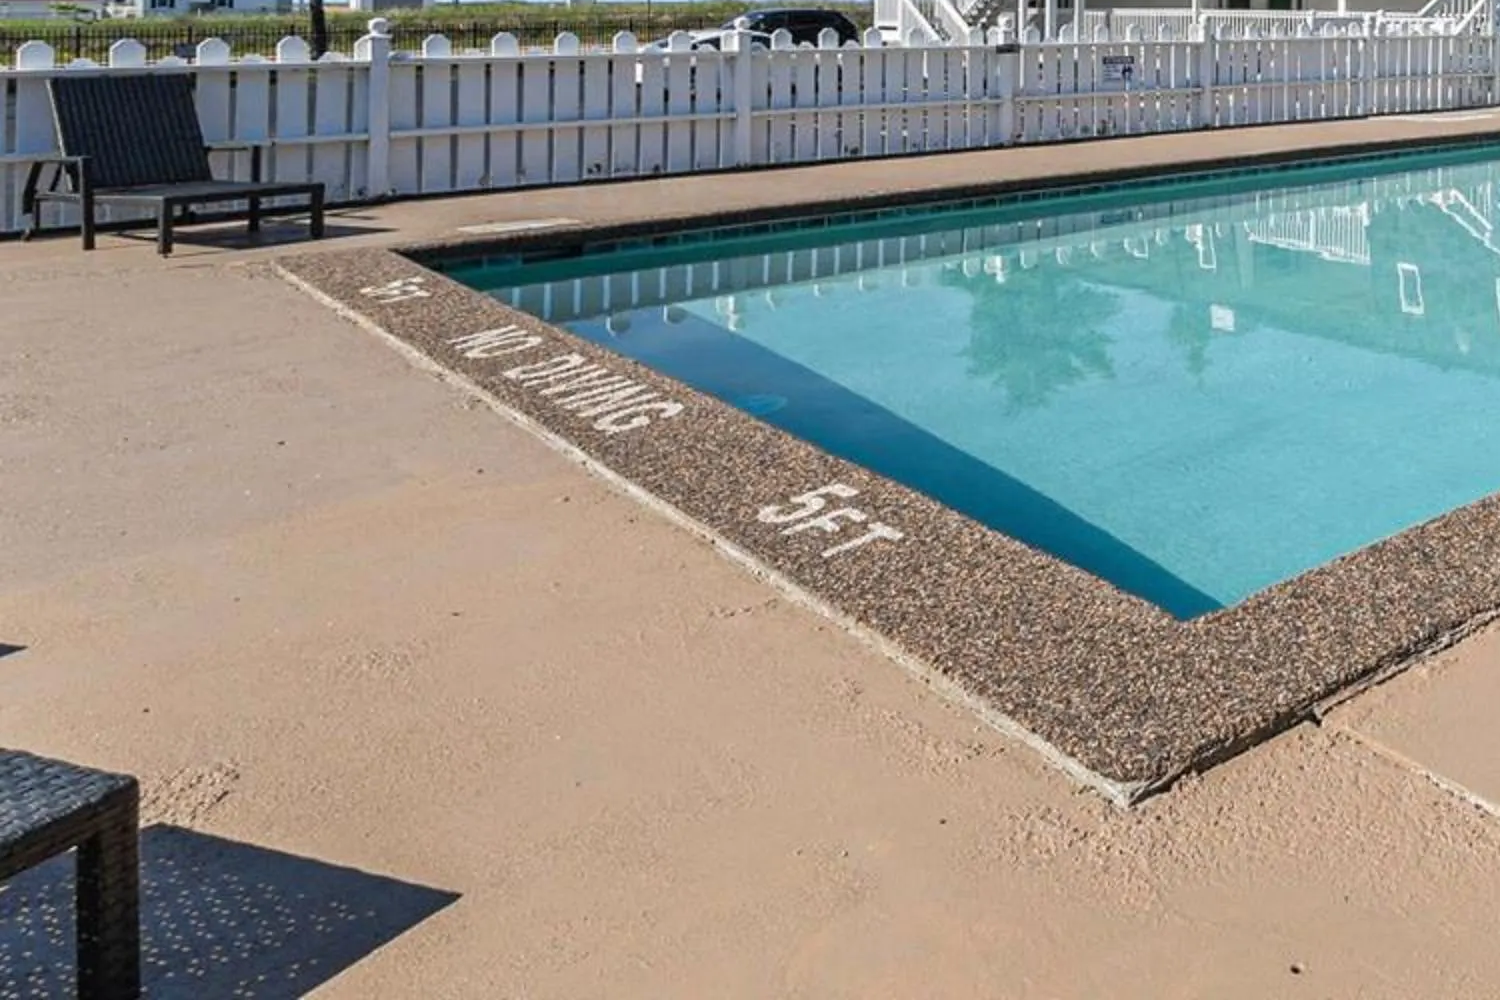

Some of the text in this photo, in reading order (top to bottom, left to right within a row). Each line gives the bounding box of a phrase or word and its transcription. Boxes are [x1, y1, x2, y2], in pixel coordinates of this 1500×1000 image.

[446, 324, 685, 434] NO DIVING
[756, 483, 905, 558] 5FT
